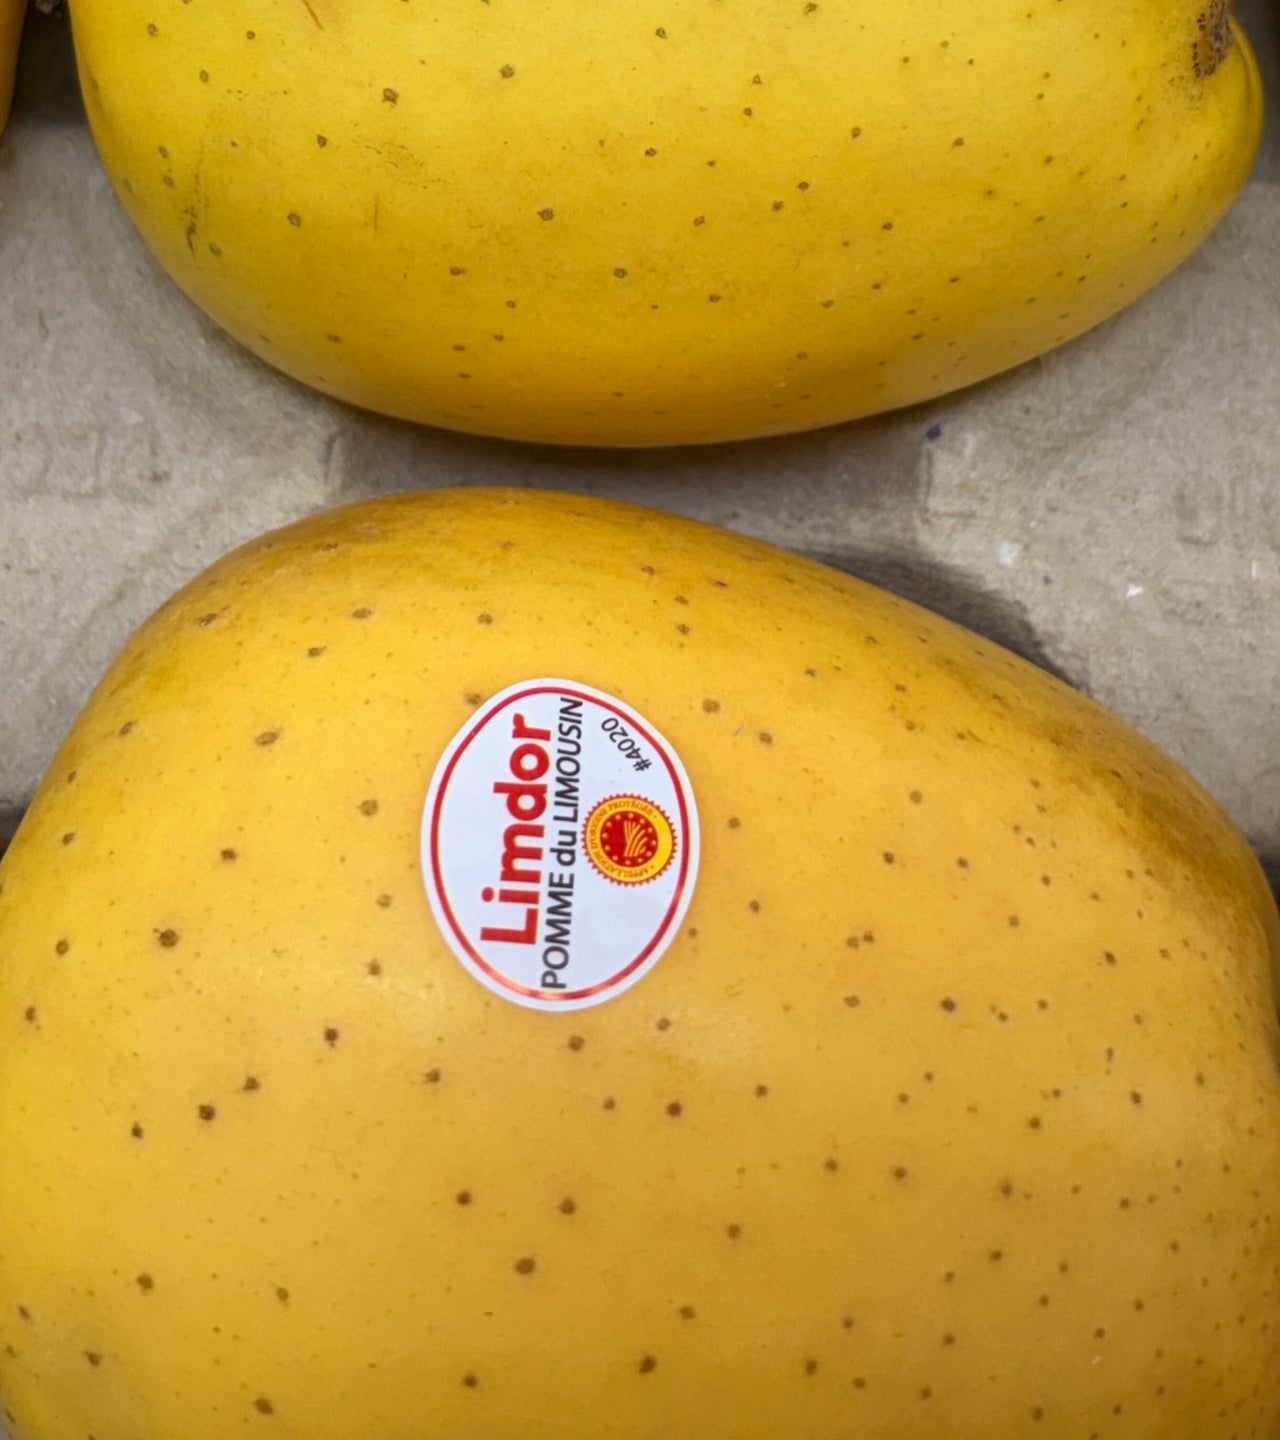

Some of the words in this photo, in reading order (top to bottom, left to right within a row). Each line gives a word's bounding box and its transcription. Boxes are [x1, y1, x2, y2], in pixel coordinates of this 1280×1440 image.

[553, 697, 583, 825] LIMOUSIN
[601, 717, 652, 772] #4020
[480, 713, 551, 945] Limdor
[549, 830, 577, 867] du
[541, 873, 575, 989] POMME
